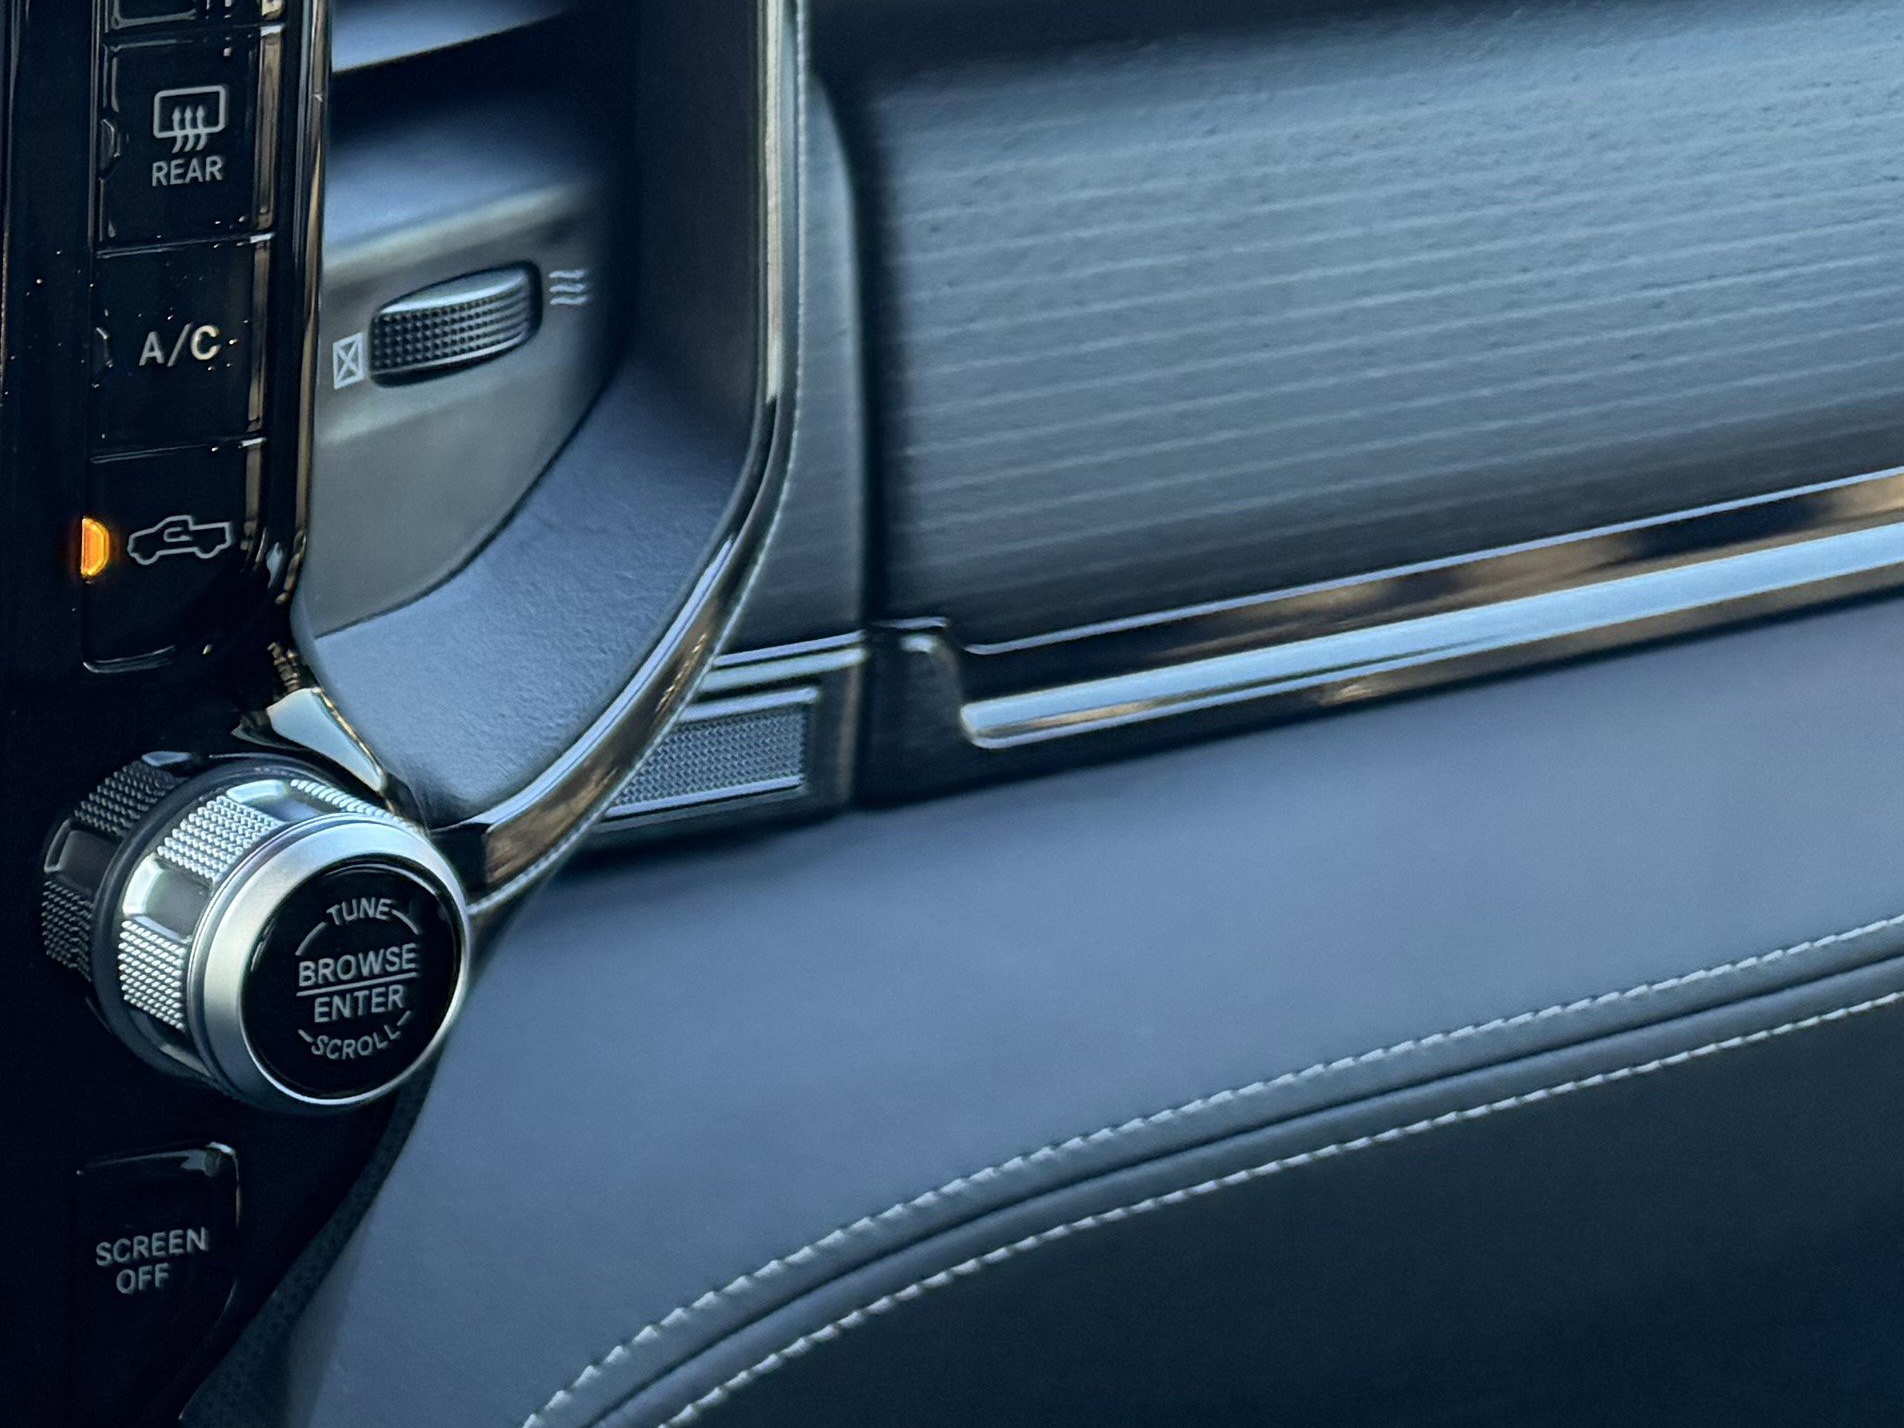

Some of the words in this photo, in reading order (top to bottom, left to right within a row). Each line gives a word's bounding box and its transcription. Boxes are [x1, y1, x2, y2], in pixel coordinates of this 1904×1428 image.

[151, 155, 225, 187] REAR
[138, 323, 221, 368] A/C
[325, 897, 391, 925] TUNE
[297, 942, 418, 986] BROWSE
[313, 987, 404, 1024] ENTER
[310, 1022, 401, 1060] SCROLL
[95, 1225, 210, 1267] SCREEN
[115, 1264, 169, 1295] OFF
